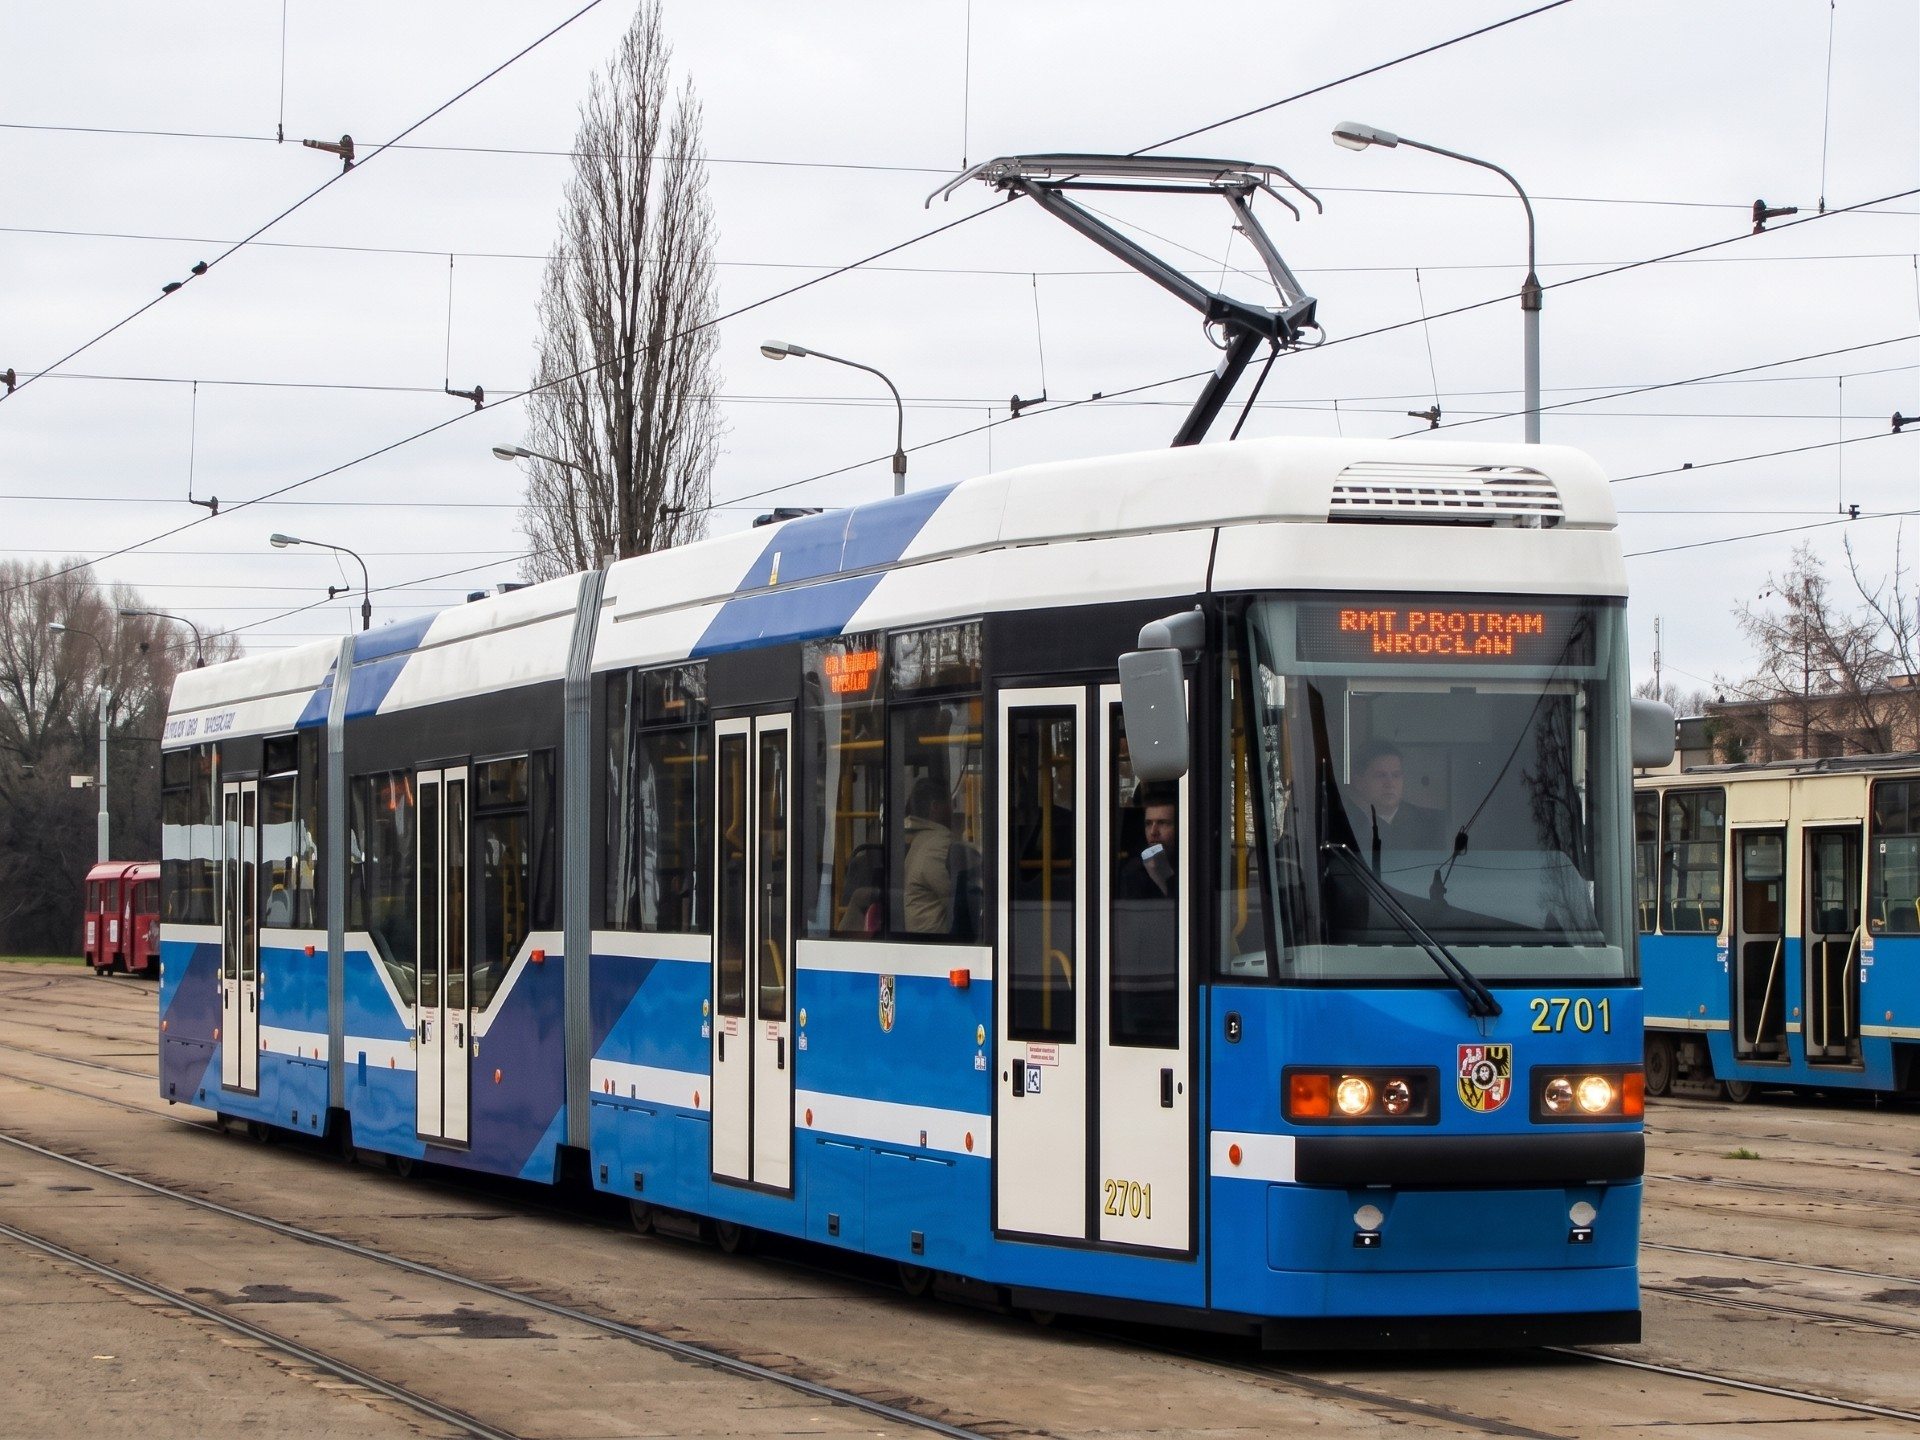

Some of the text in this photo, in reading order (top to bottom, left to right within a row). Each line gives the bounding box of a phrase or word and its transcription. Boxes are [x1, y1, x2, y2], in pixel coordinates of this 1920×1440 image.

[1340, 610, 1543, 634] RMT PROTRAM
[1530, 997, 1612, 1034] 2701
[1104, 1178, 1152, 1220] 2701
